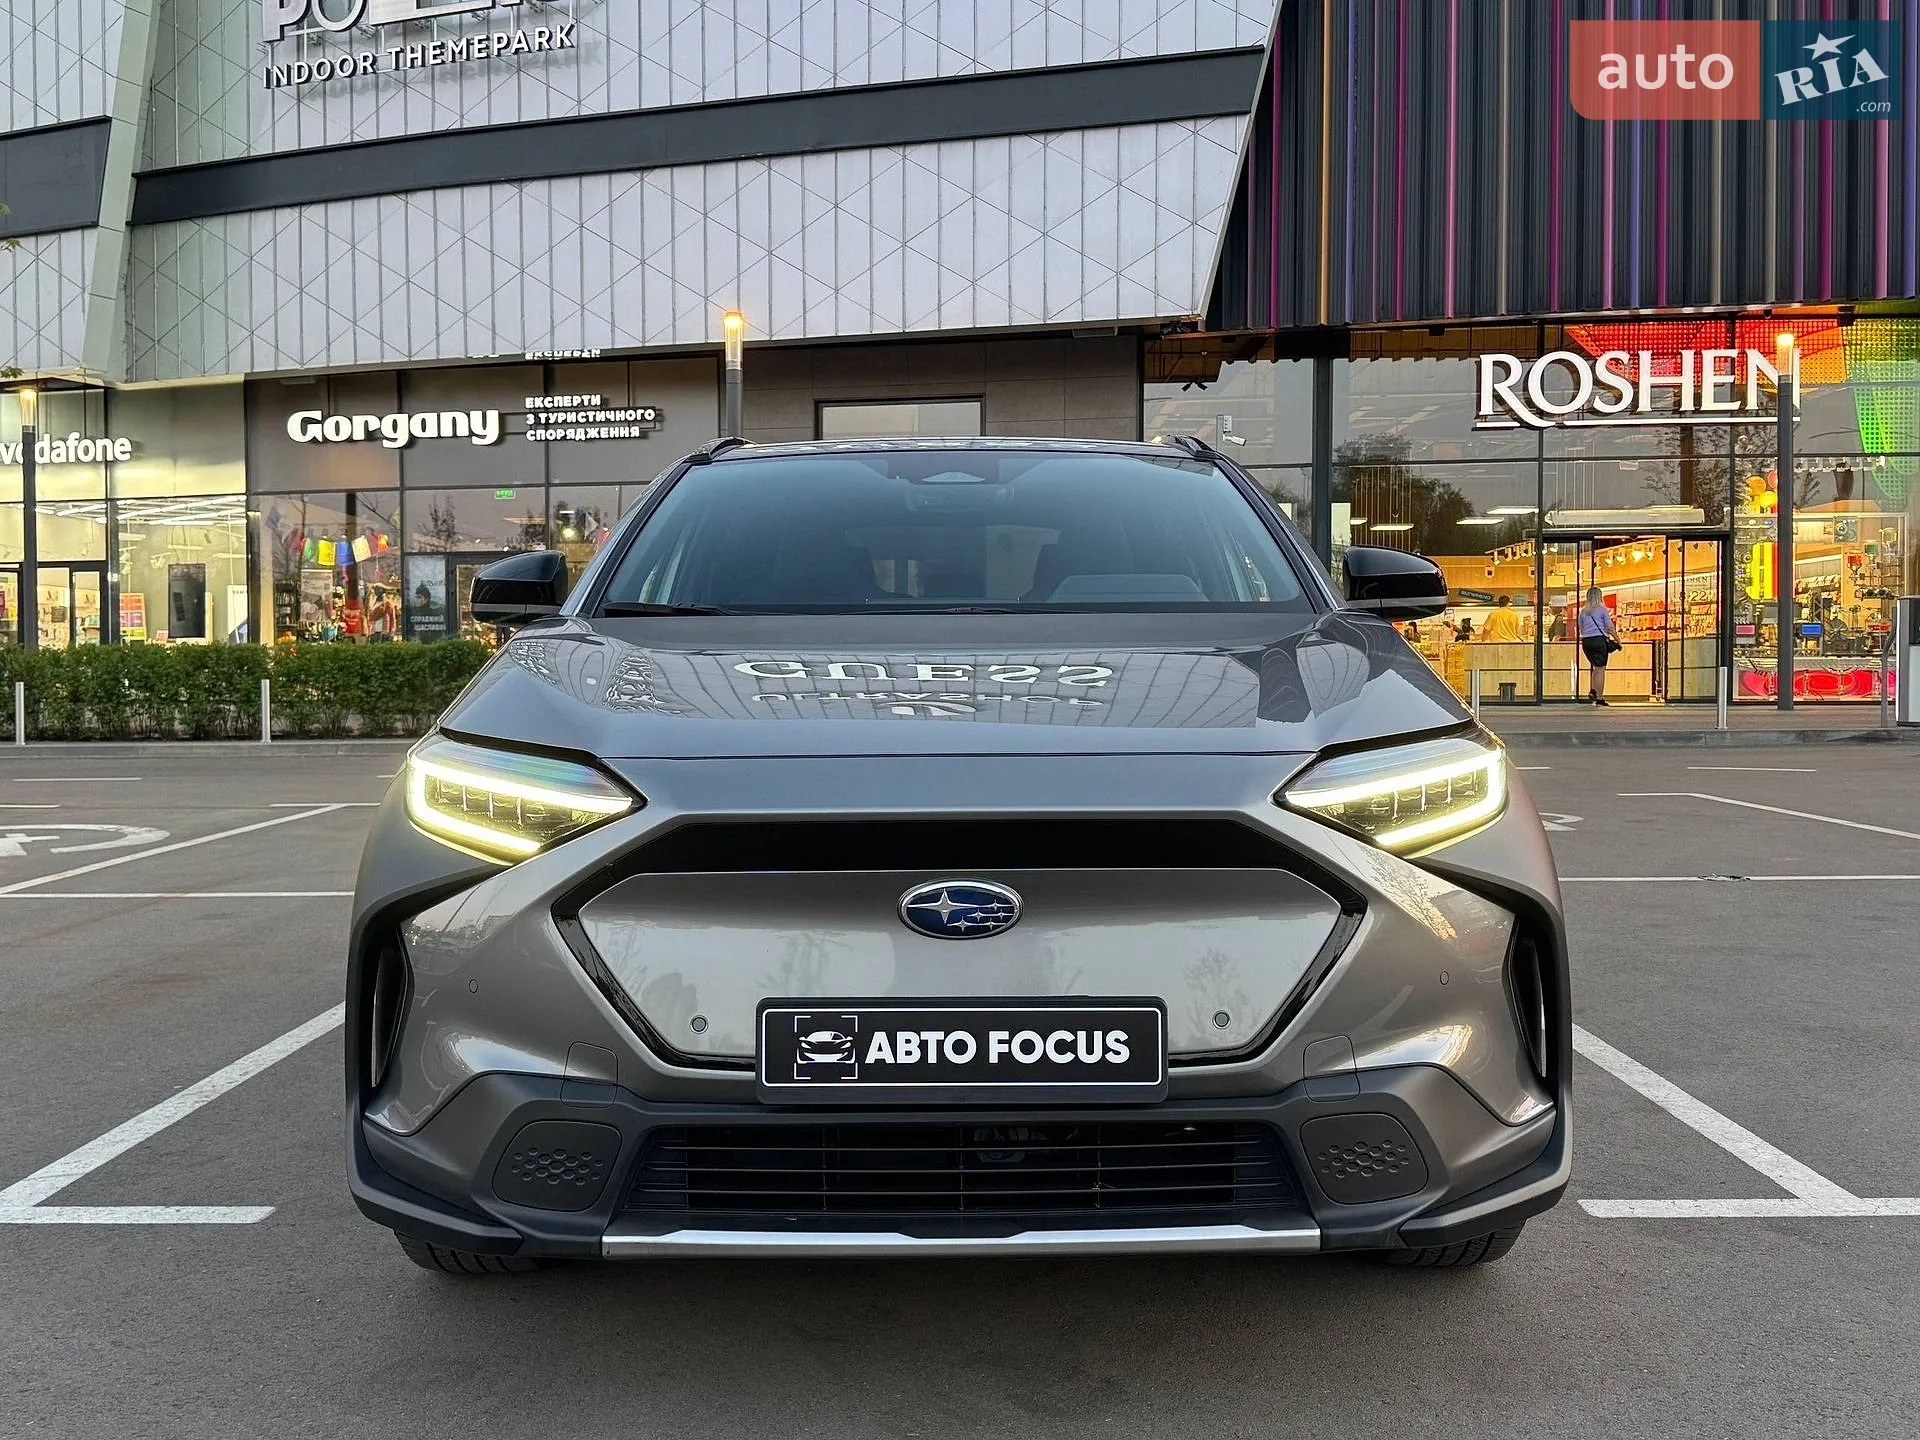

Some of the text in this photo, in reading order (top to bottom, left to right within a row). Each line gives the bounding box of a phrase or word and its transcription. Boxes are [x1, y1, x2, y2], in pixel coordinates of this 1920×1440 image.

[264, 23, 576, 88] INDOOR THEMEPARK
[525, 395, 601, 409] ЕКСПЕРТИ
[1479, 348, 1800, 427] ROSHEN
[287, 409, 499, 449] Gorgany
[526, 426, 640, 441] СПОРЯДЖЕННЯ
[539, 409, 655, 424] ТУРИСТИЧНОГО
[865, 1030, 1130, 1064] АВТО FOCUS
